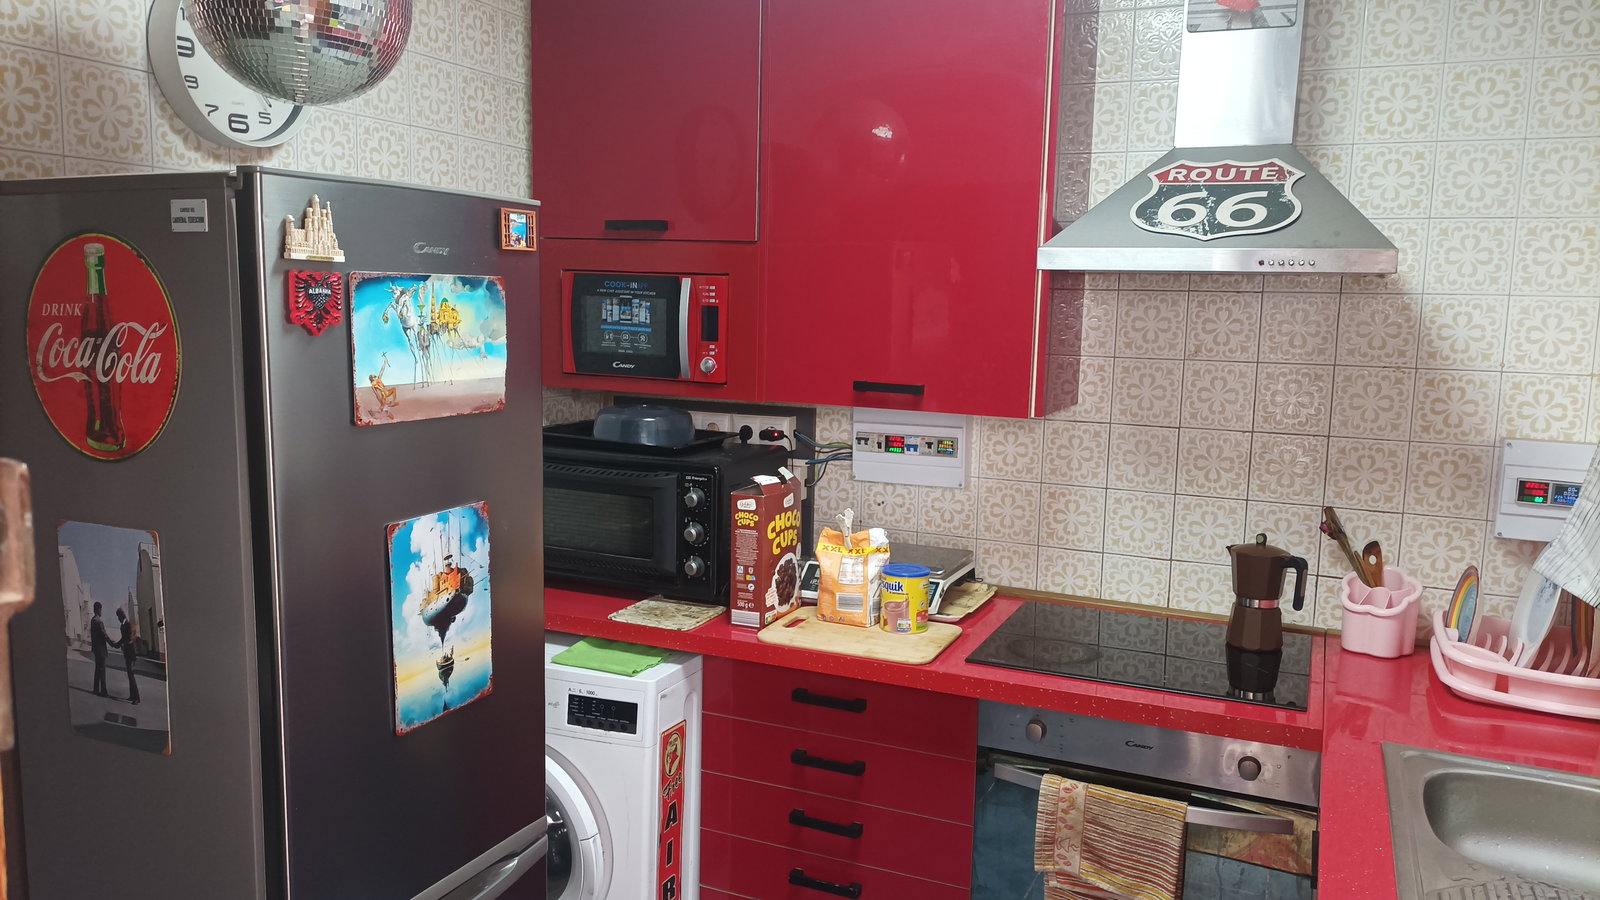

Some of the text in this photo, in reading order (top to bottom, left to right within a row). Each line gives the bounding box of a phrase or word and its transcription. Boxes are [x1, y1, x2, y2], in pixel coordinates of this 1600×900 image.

[184, 75, 199, 89] 8
[205, 104, 219, 117] 7
[228, 113, 249, 134] 6
[258, 112, 271, 125] 5
[1167, 166, 1280, 182] ROUTE
[1158, 191, 1270, 227] 66
[41, 303, 83, 317] DRINK
[735, 511, 759, 522] CHOCO
[737, 519, 755, 527] CUPS
[767, 509, 800, 540] CHOCO
[772, 529, 798, 555] CUPS
[822, 544, 843, 553] XXL
[1125, 740, 1154, 750] CANDY
[662, 771, 682, 801] Free
